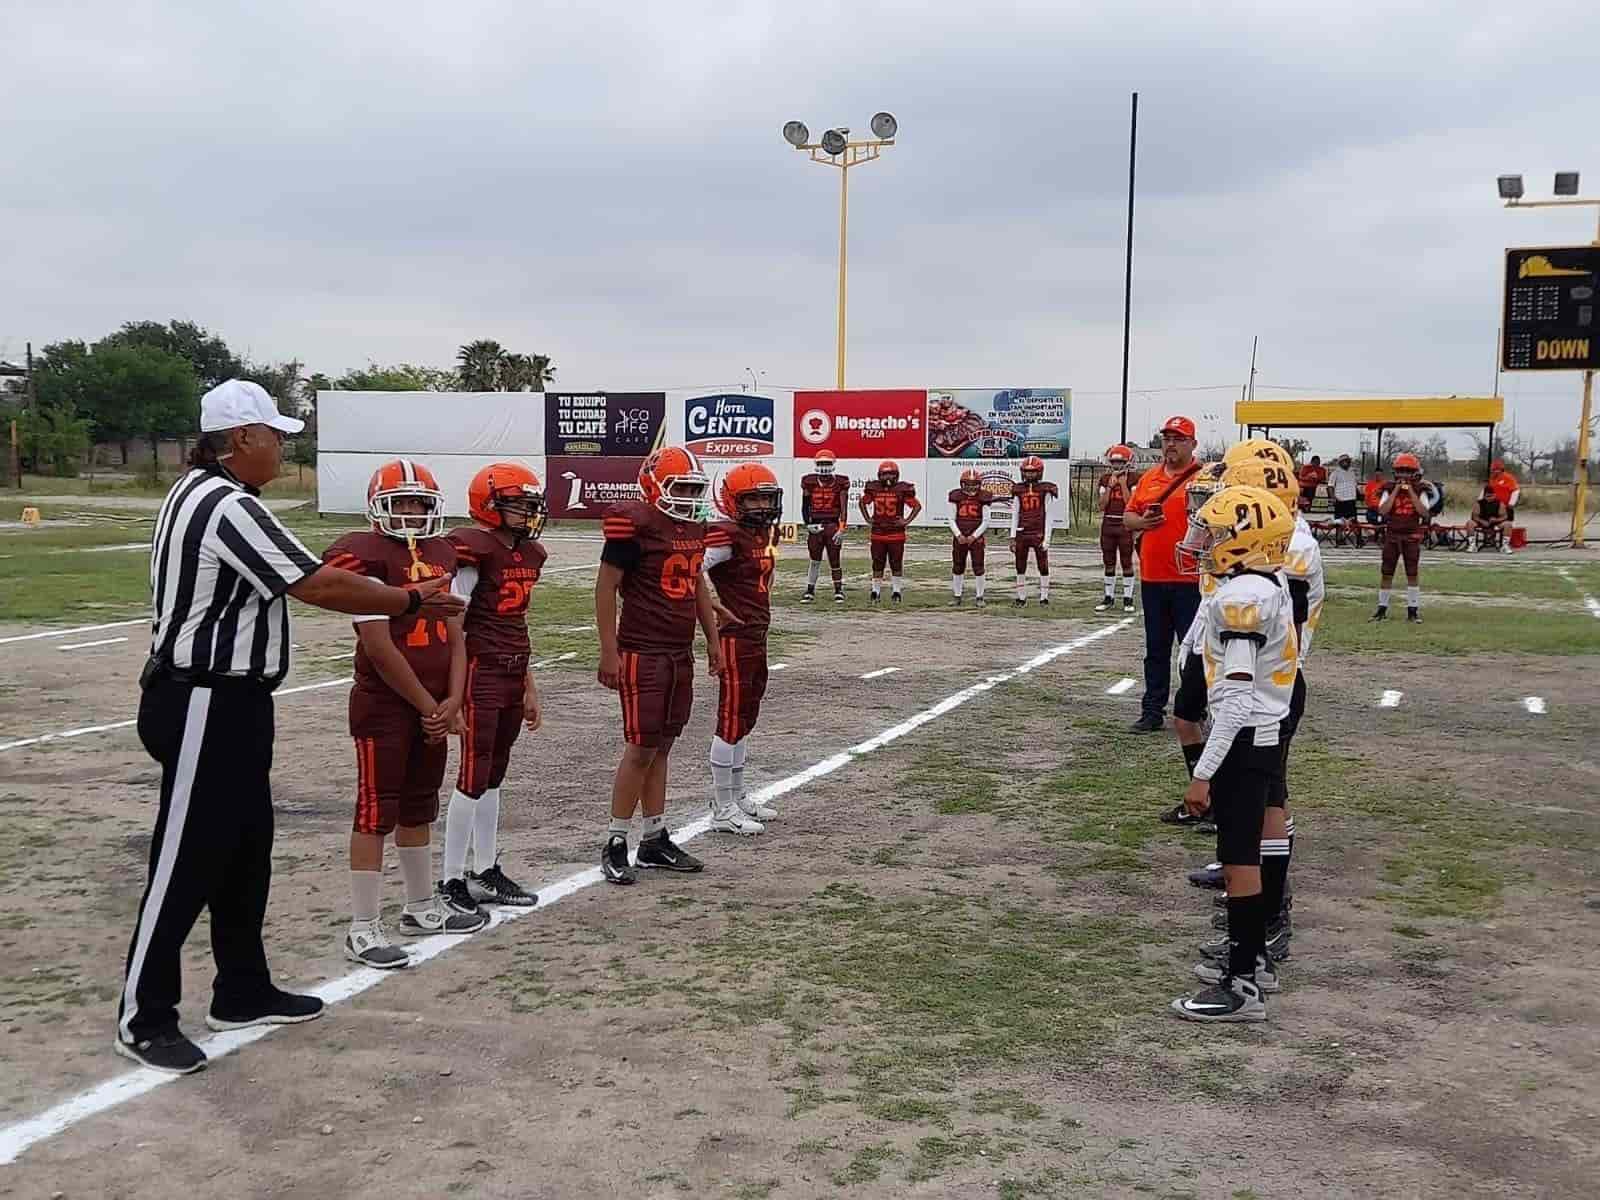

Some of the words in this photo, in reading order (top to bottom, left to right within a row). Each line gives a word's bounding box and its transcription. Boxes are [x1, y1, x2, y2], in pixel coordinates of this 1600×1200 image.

[1536, 339, 1590, 360] DOWN
[558, 396, 571, 407] TU
[573, 396, 607, 407] EQUIPO
[558, 409, 571, 420] TU
[572, 409, 606, 420] CIUDAD
[688, 406, 772, 434] CENTRO
[558, 421, 573, 434] TU
[835, 415, 919, 430] Mostacho's
[861, 430, 885, 438] PIZZA
[705, 442, 758, 455] Express
[1263, 467, 1289, 489] 24
[584, 482, 596, 491] LA
[597, 482, 642, 492] GRANDEZ
[584, 491, 599, 499] DE
[600, 491, 642, 500] COAHUIL
